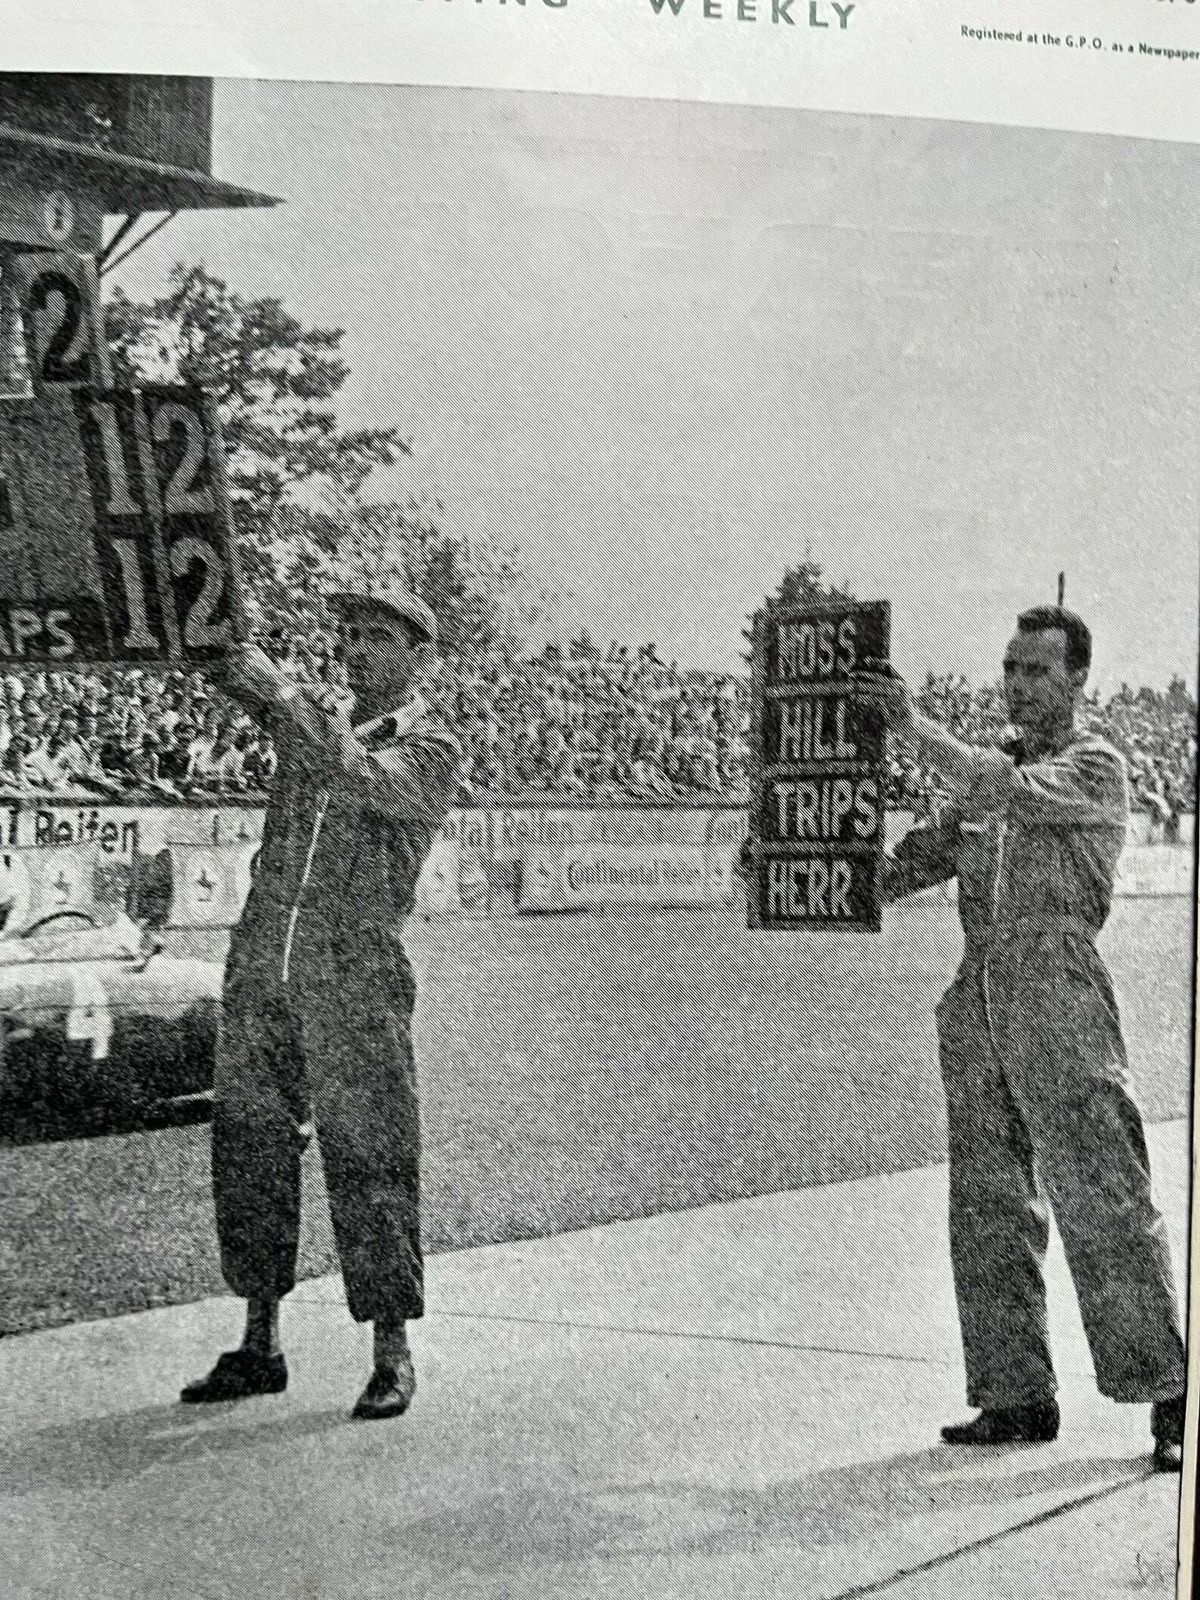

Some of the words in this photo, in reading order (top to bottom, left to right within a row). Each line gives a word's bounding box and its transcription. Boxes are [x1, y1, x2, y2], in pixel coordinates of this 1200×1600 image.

[650, 0, 855, 29] WEEKLY
[961, 25, 1023, 41] Registered
[1027, 34, 1038, 44] at
[1043, 34, 1061, 46] the
[1066, 36, 1107, 51] G.P.O.
[1111, 43, 1124, 52] as
[1127, 45, 1134, 53] a
[1139, 43, 1200, 61] Newspaper
[777, 619, 857, 679] MOSS
[779, 701, 858, 759] HILL
[35, 808, 139, 853] Reifen
[773, 778, 878, 838] TRIPS
[768, 859, 853, 917] HERR
